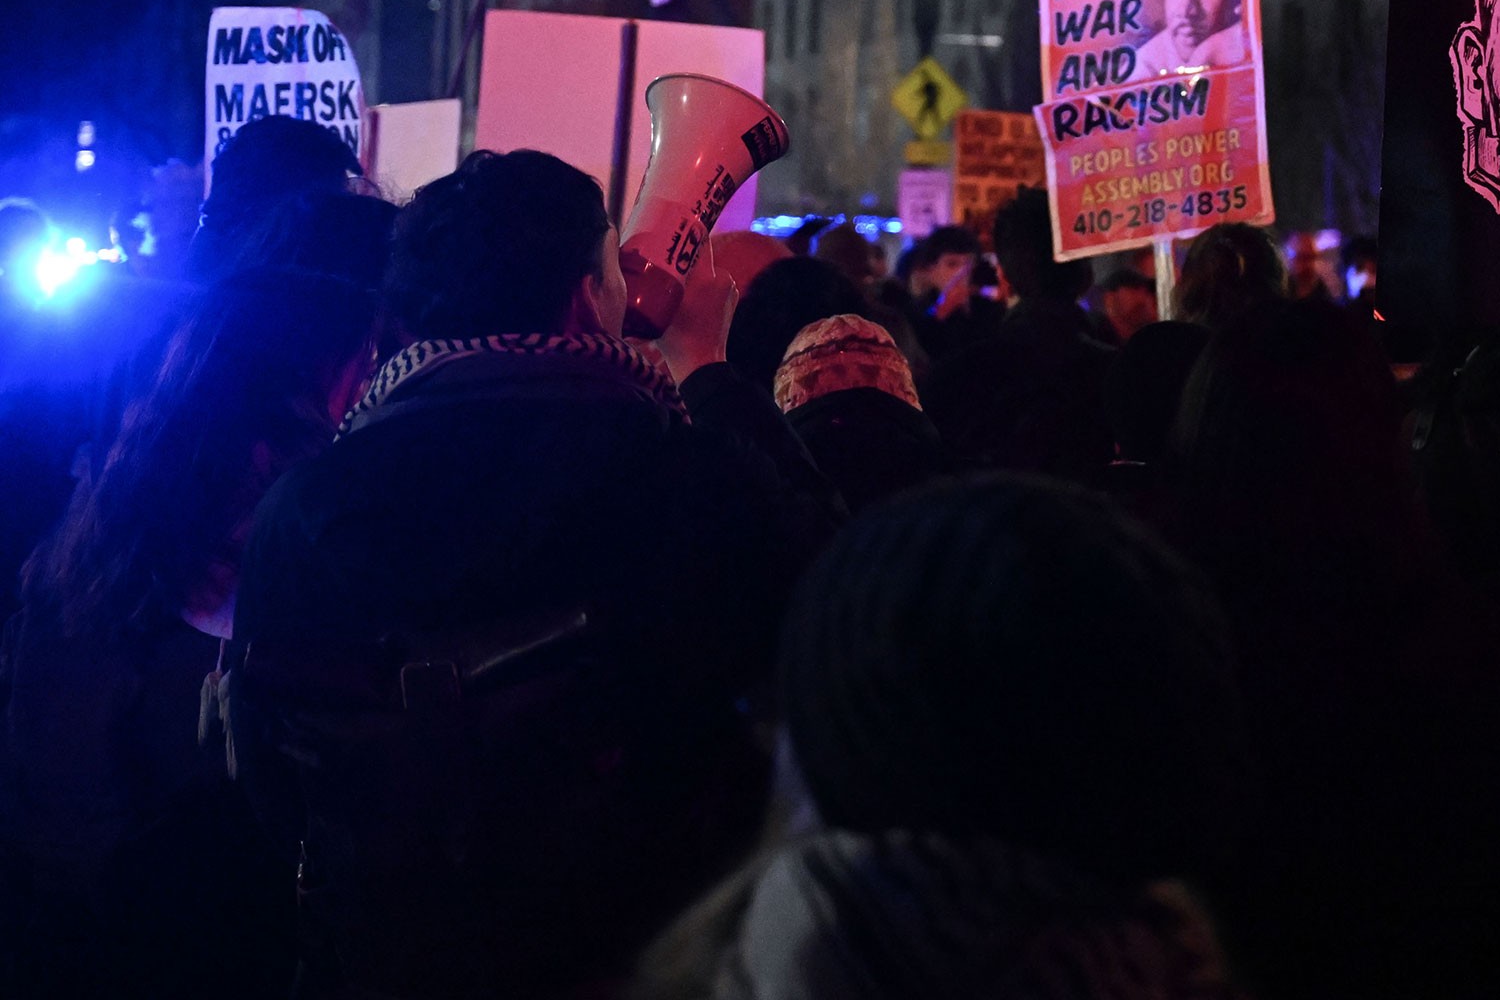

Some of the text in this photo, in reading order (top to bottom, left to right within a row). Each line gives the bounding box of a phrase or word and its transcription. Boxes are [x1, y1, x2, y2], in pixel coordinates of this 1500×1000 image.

[213, 24, 309, 65] MASK
[1056, 45, 1137, 95] AND
[214, 79, 360, 123] MAERSK
[1053, 76, 1210, 142] RACISM
[1071, 142, 1159, 178] PEOPLES
[1165, 128, 1241, 161] POWER
[1081, 160, 1234, 207] ASSEMBLY.ORG
[1073, 185, 1248, 236] 410-218-4835
